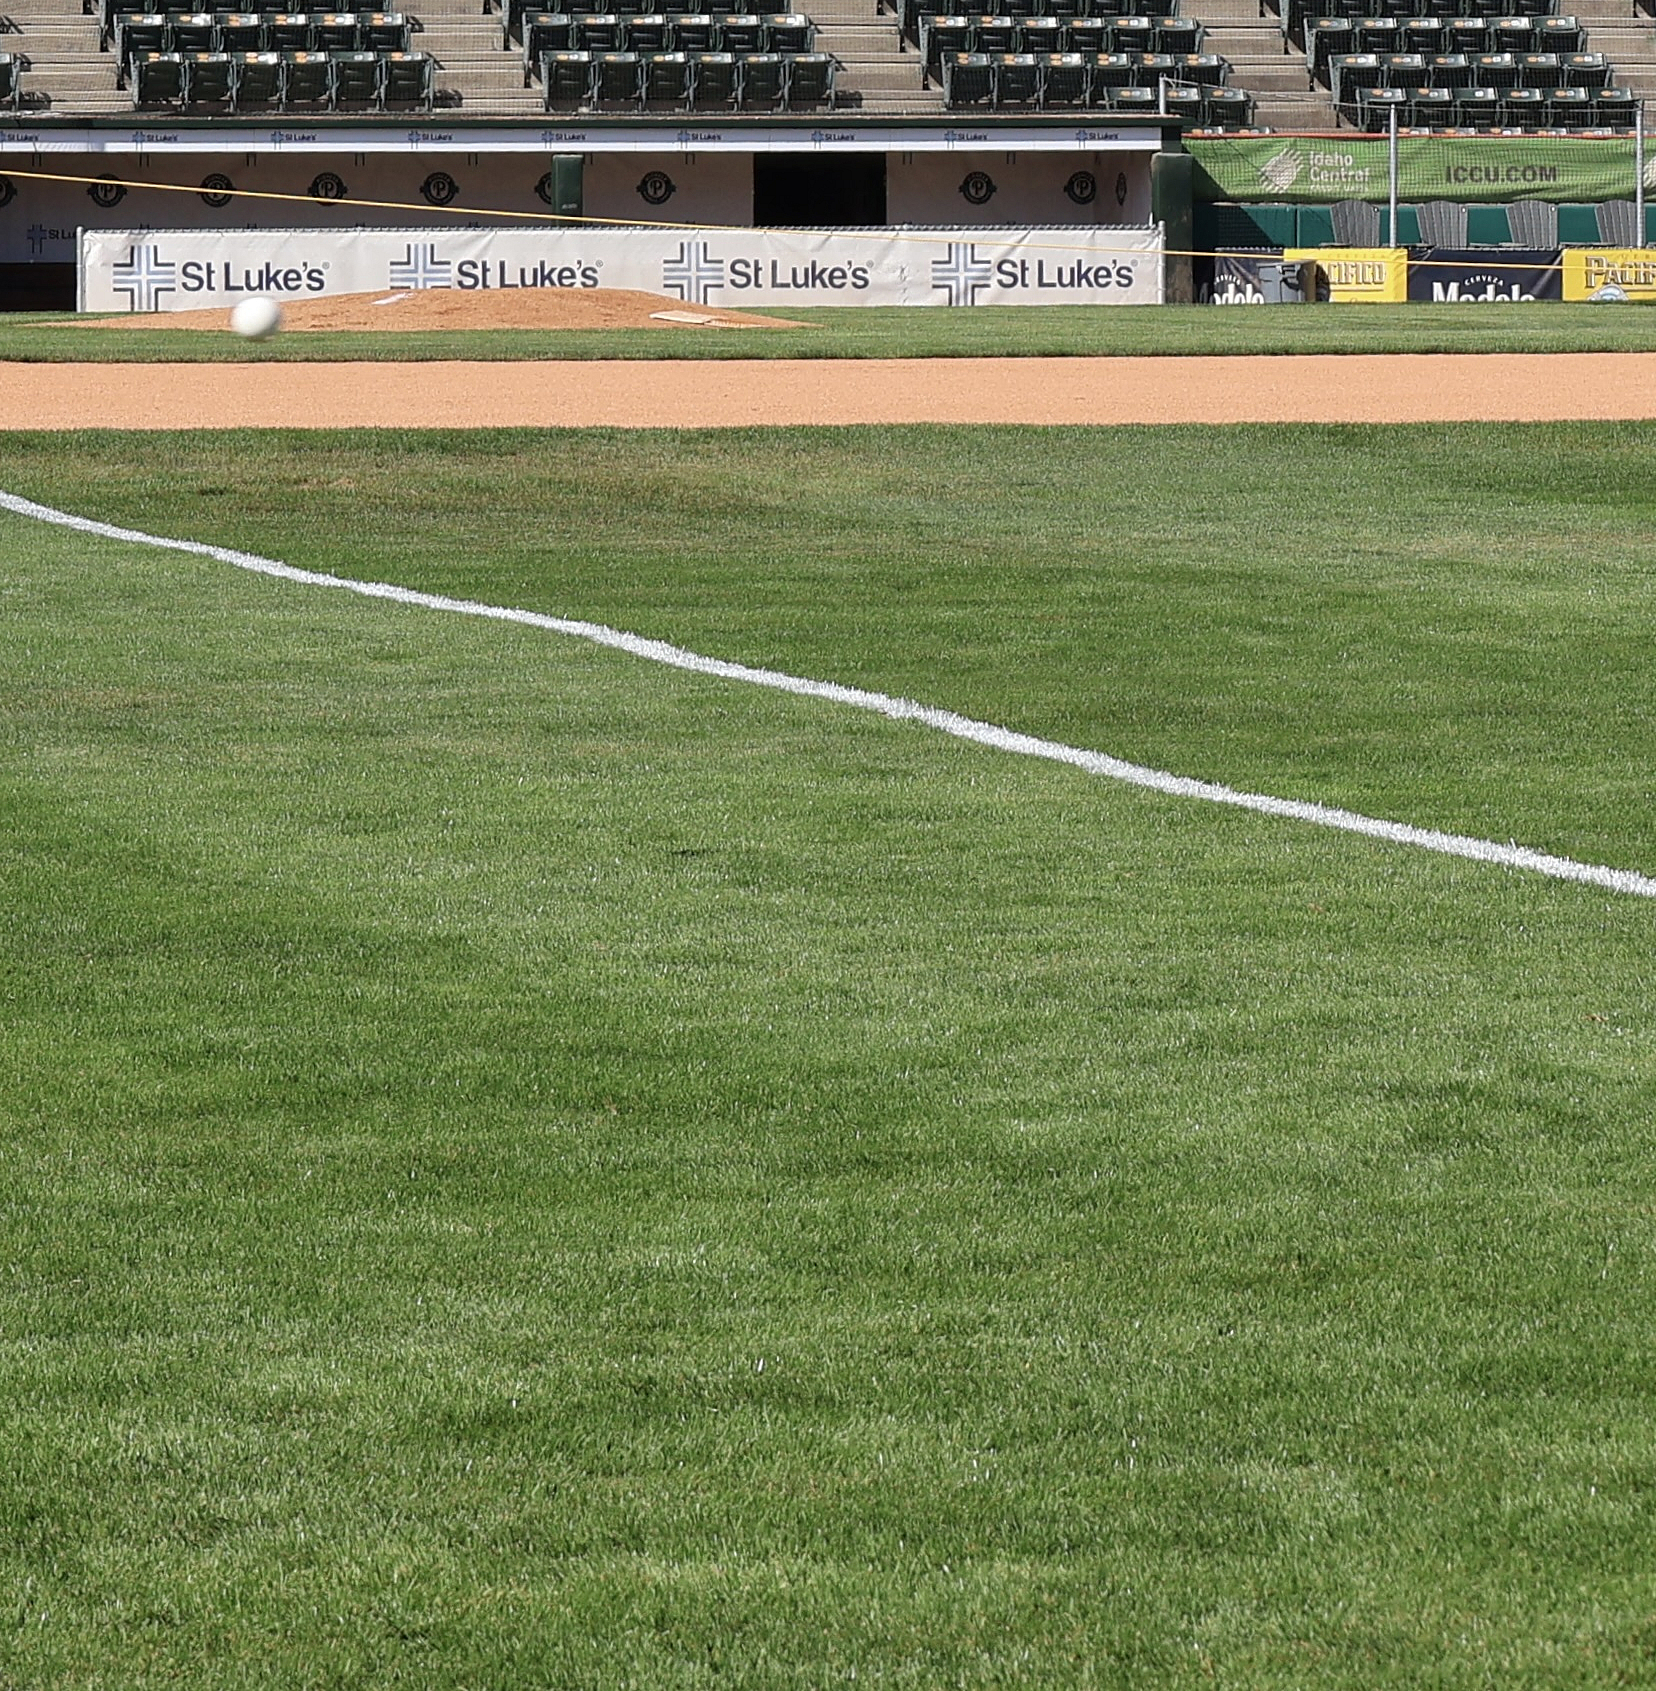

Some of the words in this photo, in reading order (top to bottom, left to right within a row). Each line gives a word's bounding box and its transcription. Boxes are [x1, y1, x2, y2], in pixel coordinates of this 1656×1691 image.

[1309, 151, 1354, 167] Idaho
[1309, 167, 1371, 183] Central
[1446, 165, 1558, 184] ICCU.COM
[181, 261, 216, 292] St
[457, 259, 491, 289] St
[729, 259, 763, 289] St
[995, 258, 1030, 288] St
